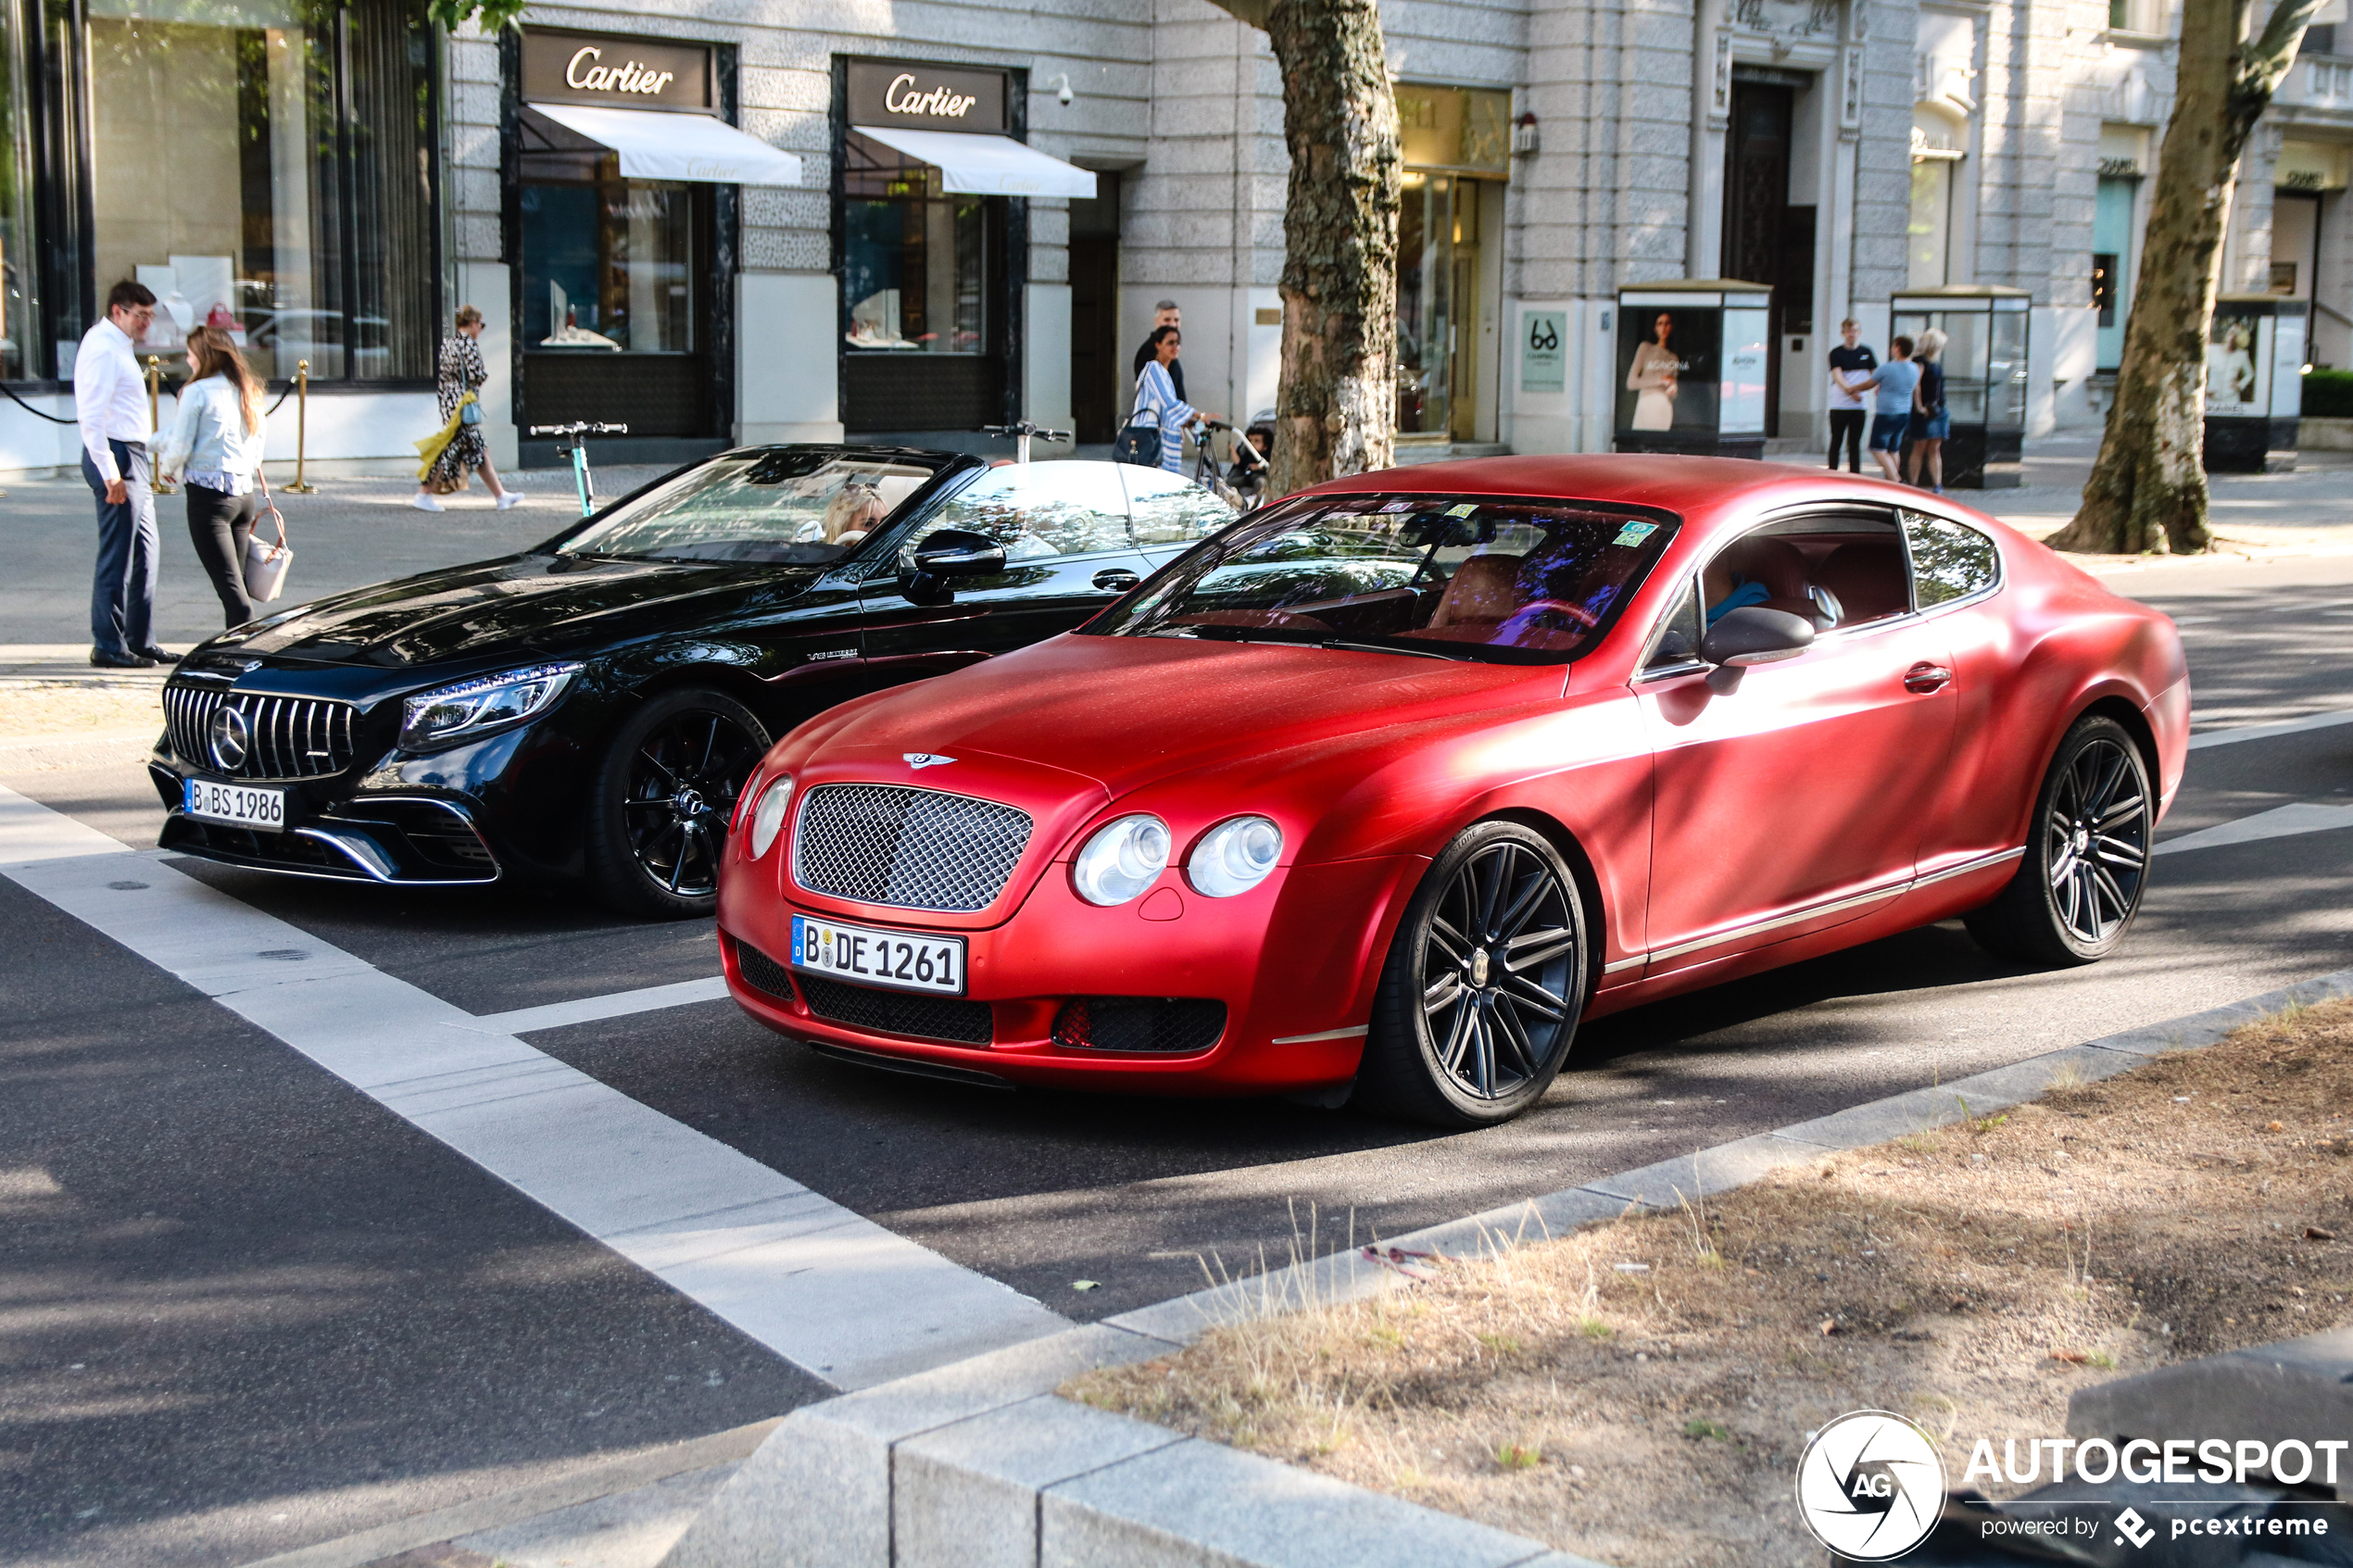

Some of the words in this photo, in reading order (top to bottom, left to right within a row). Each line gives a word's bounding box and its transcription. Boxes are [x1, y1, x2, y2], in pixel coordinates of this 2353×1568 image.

[566, 46, 673, 94] Cartier
[885, 73, 975, 118] Cartier
[686, 157, 739, 179] Cartier
[194, 784, 203, 810] B
[211, 786, 232, 816] BS
[235, 790, 282, 822] 1986
[795, 946, 801, 957] D
[806, 924, 820, 962] B
[836, 931, 869, 973] DE
[875, 939, 956, 985] 1261
